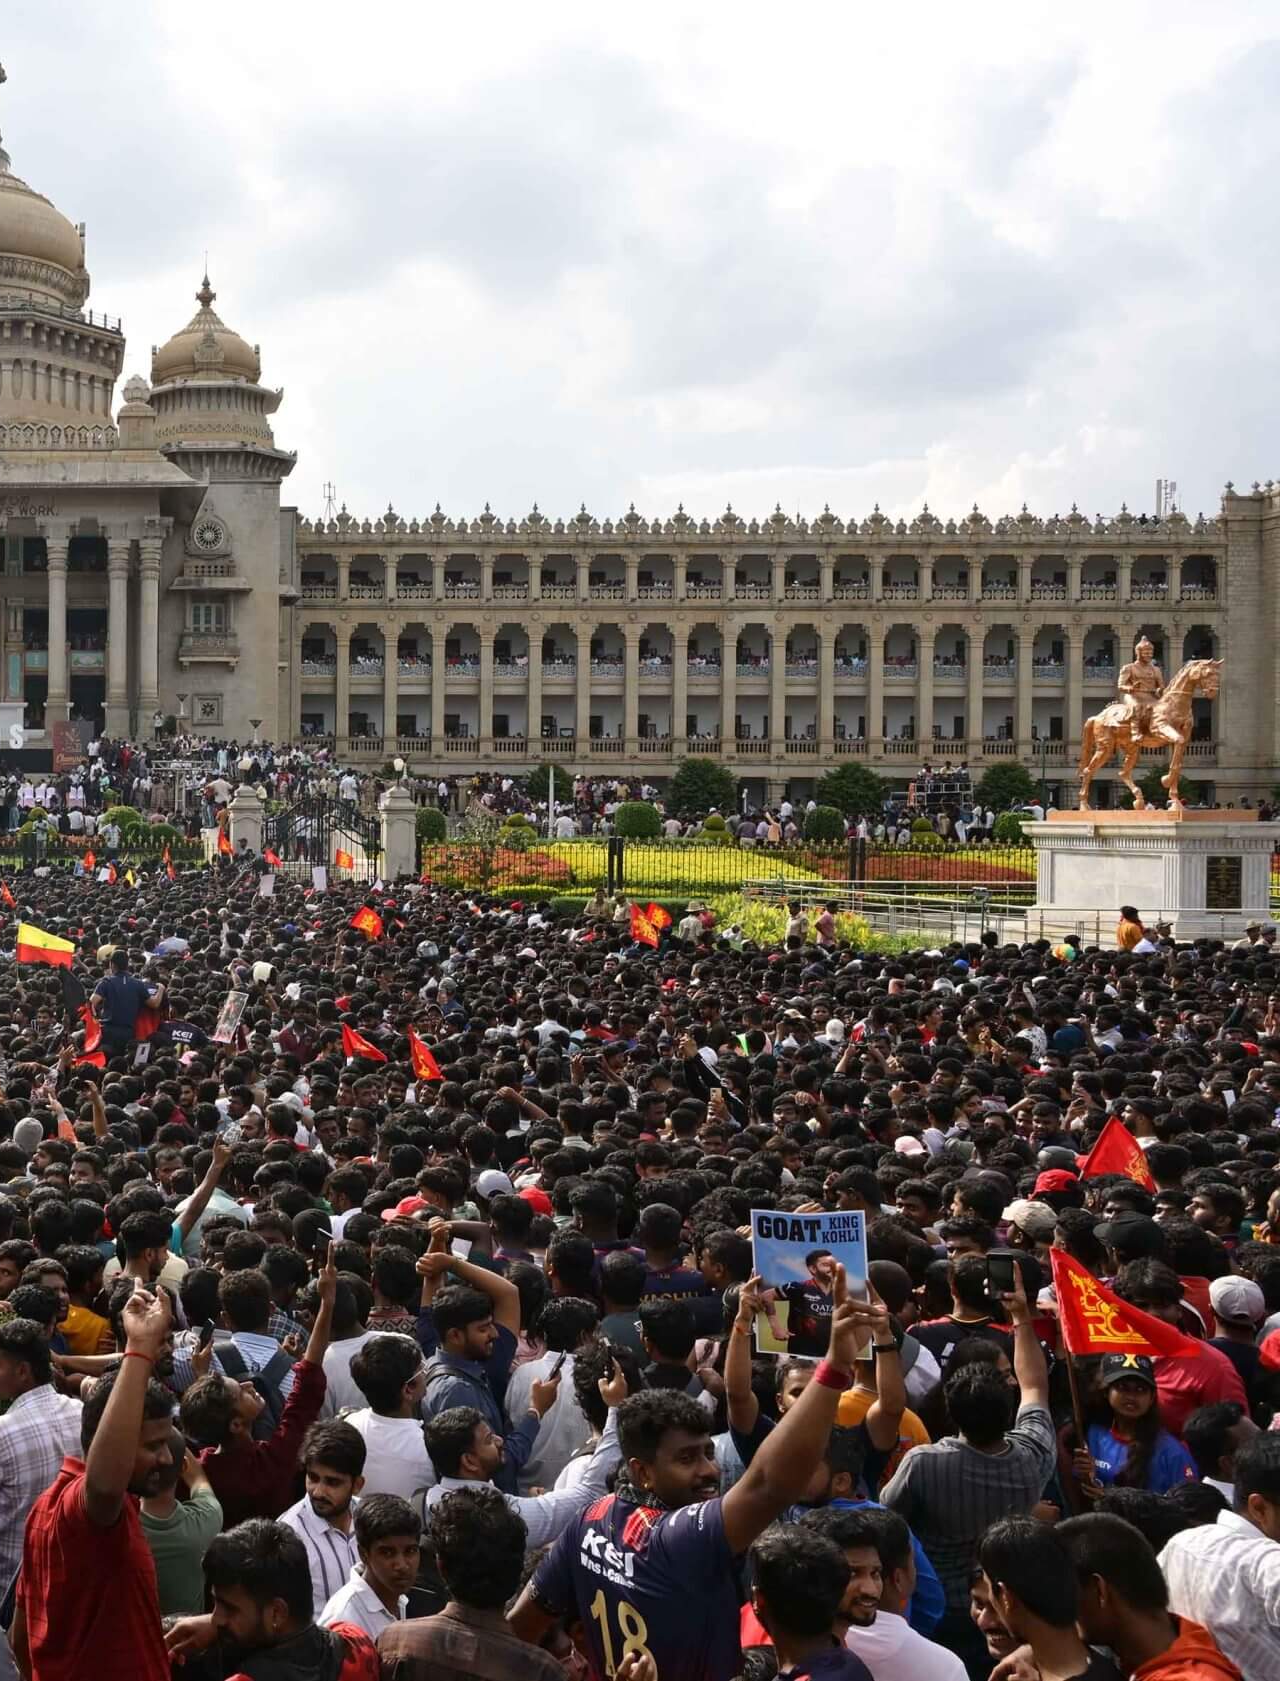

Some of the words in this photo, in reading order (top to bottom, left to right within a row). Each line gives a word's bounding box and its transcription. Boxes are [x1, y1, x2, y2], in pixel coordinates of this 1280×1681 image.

[757, 1215, 822, 1243] GOAT
[829, 1215, 859, 1230] KING
[822, 1229, 860, 1244] KOHLI
[590, 1588, 659, 1681] 18
